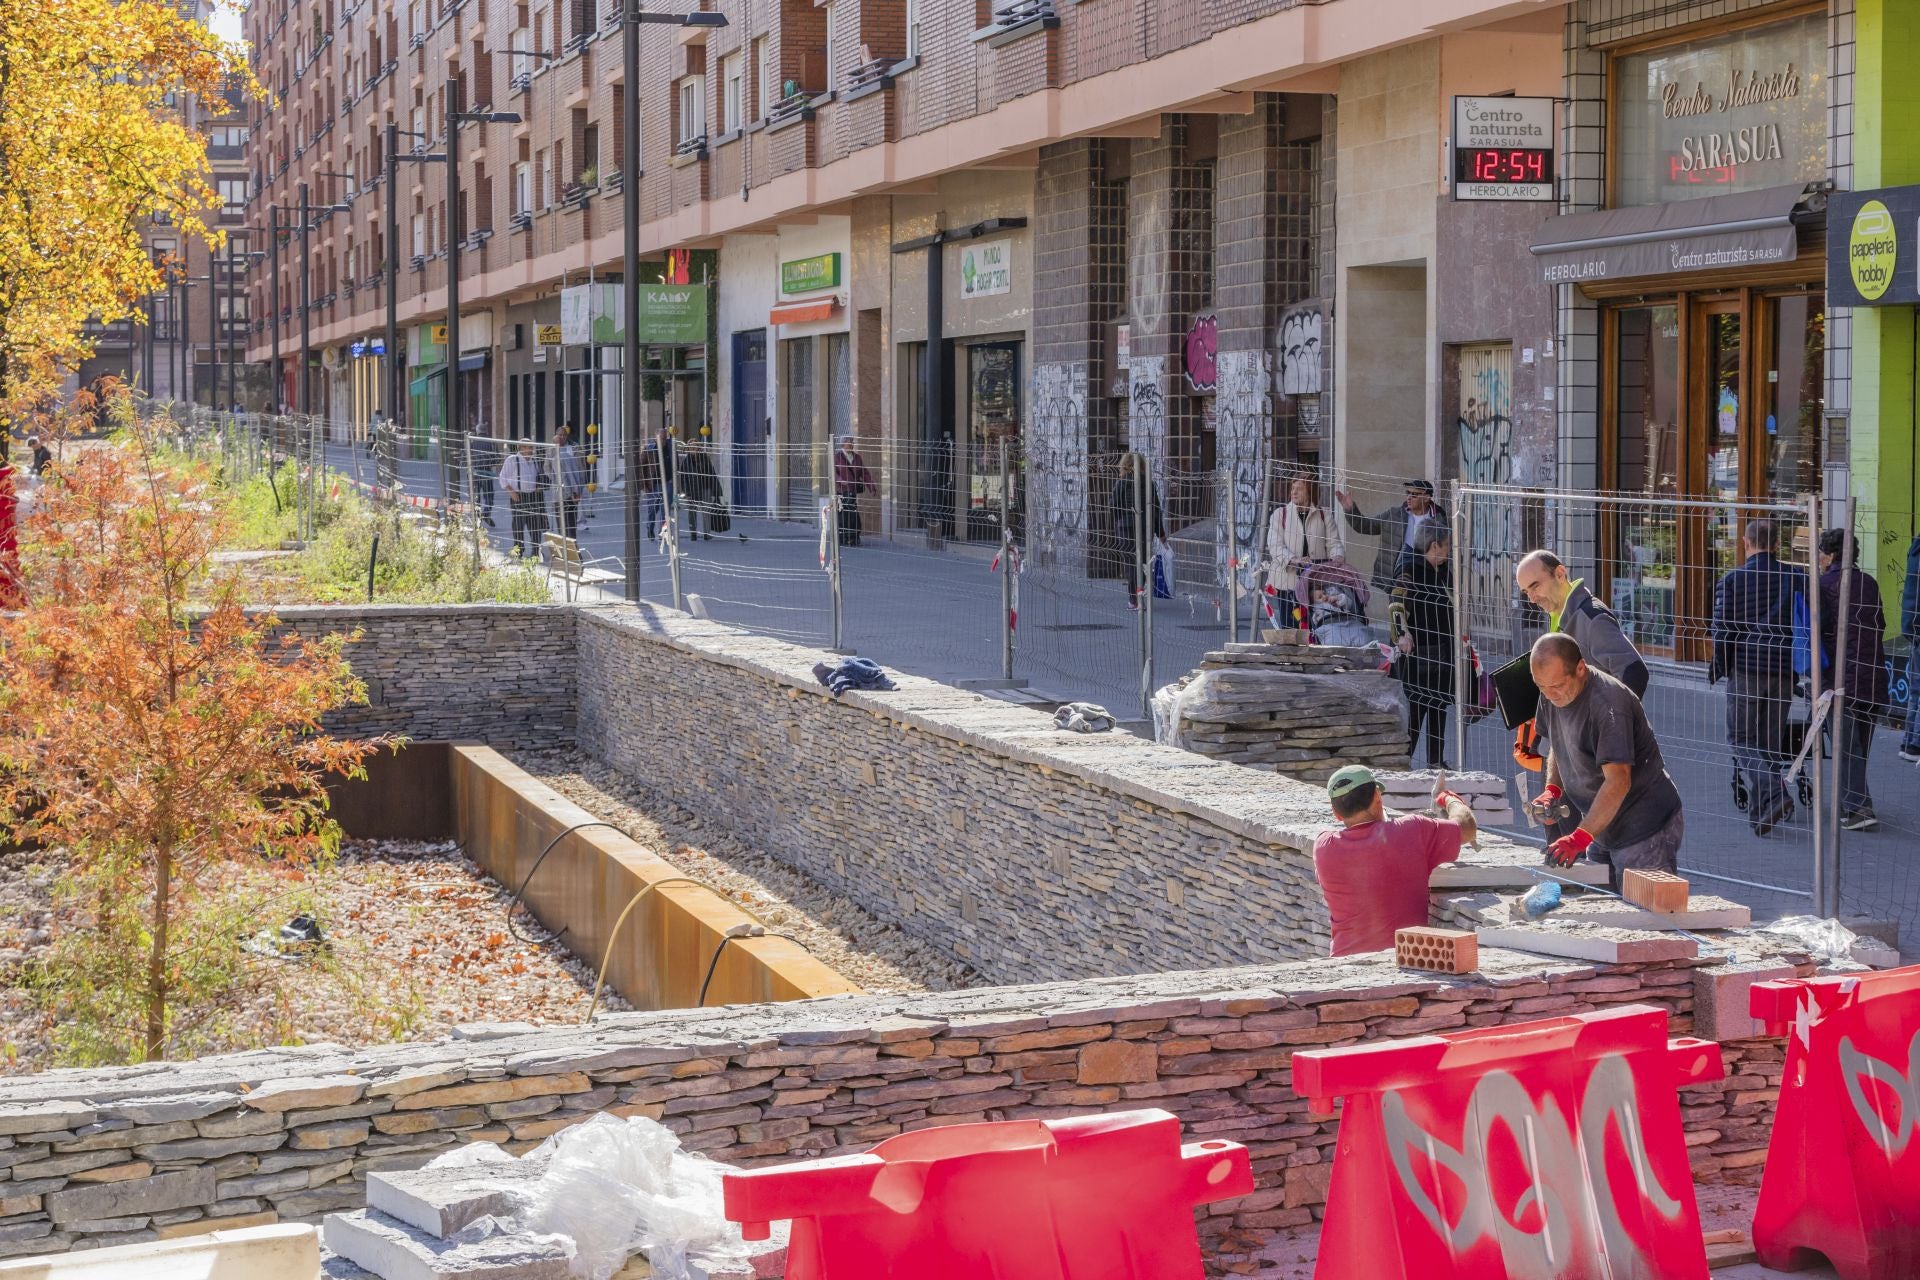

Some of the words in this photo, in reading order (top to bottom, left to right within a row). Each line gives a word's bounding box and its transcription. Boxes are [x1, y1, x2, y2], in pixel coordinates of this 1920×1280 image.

[1663, 81, 1712, 119] Centro
[1718, 63, 1799, 112] Naturista
[1466, 108, 1523, 121] Centro
[1469, 123, 1543, 136] naturista
[1470, 138, 1524, 146] SARASUA
[1681, 123, 1784, 171] SARASUA
[1475, 152, 1543, 180] 12:54
[1469, 186, 1540, 197] HERBOLARIO
[983, 245, 1001, 266] MUNDO
[1671, 251, 1703, 269] Centro
[1704, 246, 1748, 266] naturista
[1749, 247, 1783, 260] SARASUA
[1544, 261, 1606, 281] HERBOLARIO
[1858, 263, 1888, 286] hobby
